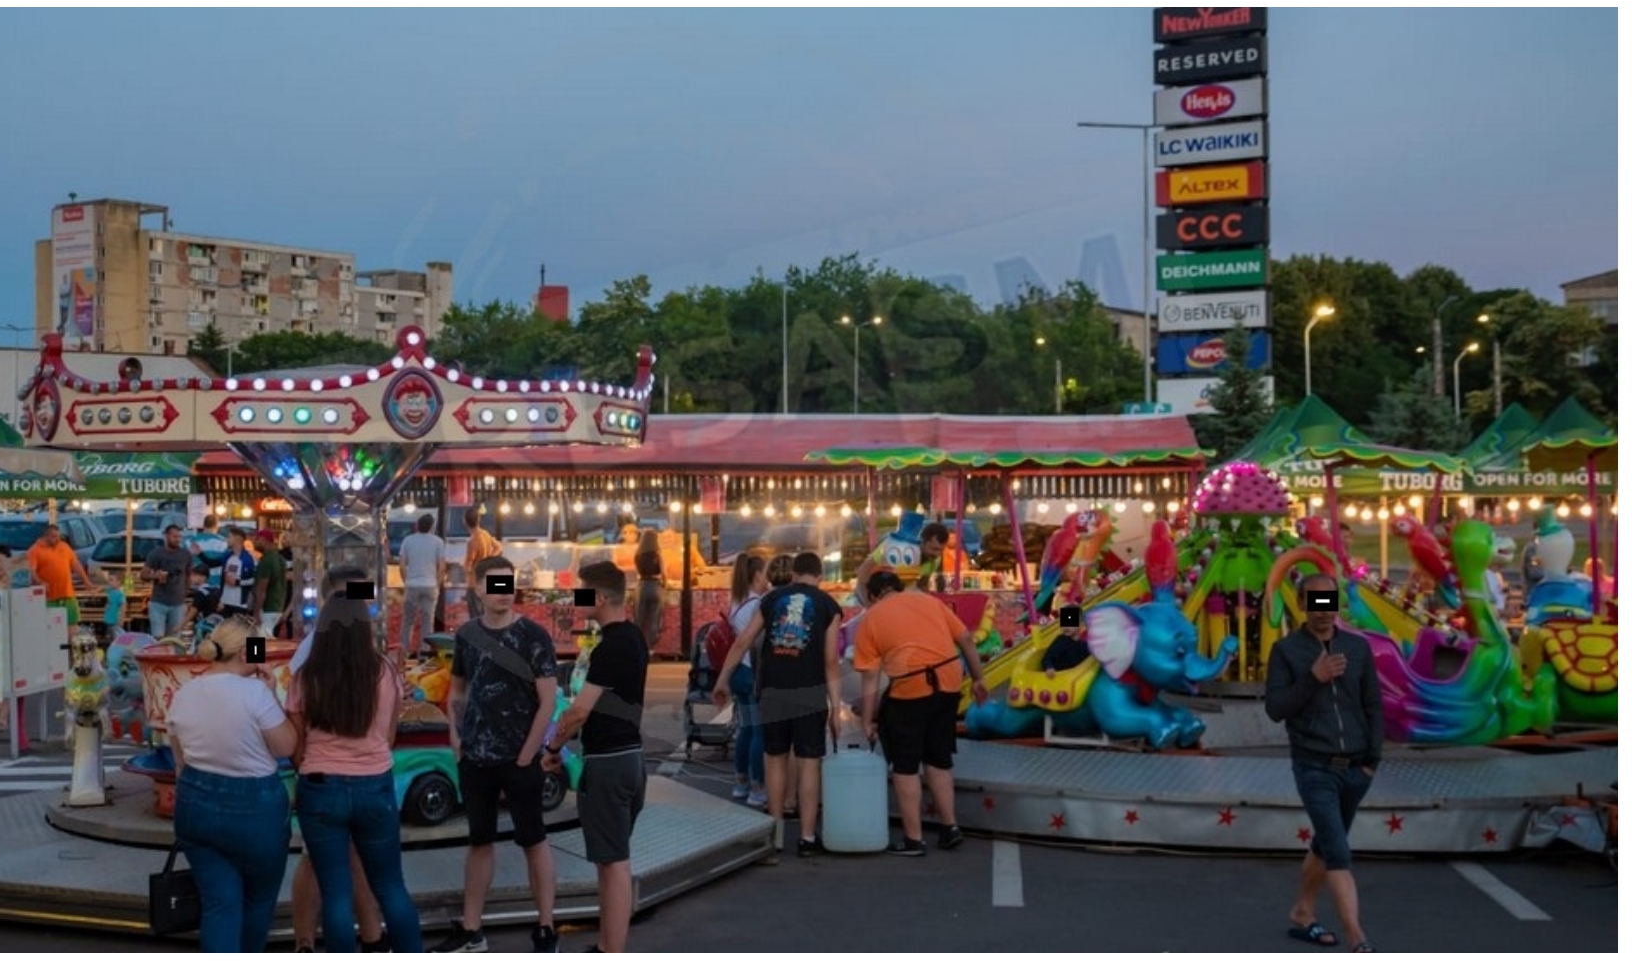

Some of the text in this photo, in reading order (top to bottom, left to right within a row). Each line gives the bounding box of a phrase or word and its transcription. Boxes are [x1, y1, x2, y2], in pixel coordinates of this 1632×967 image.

[1157, 47, 1259, 73] RESERVED
[1159, 139, 1182, 155] LC
[1176, 213, 1243, 242] CCC
[1161, 261, 1261, 280] DEICHMANN
[12, 479, 41, 491] FOR
[118, 477, 191, 495] TUBORG
[1474, 474, 1519, 486] OPEN
[1523, 474, 1558, 486] FOR
